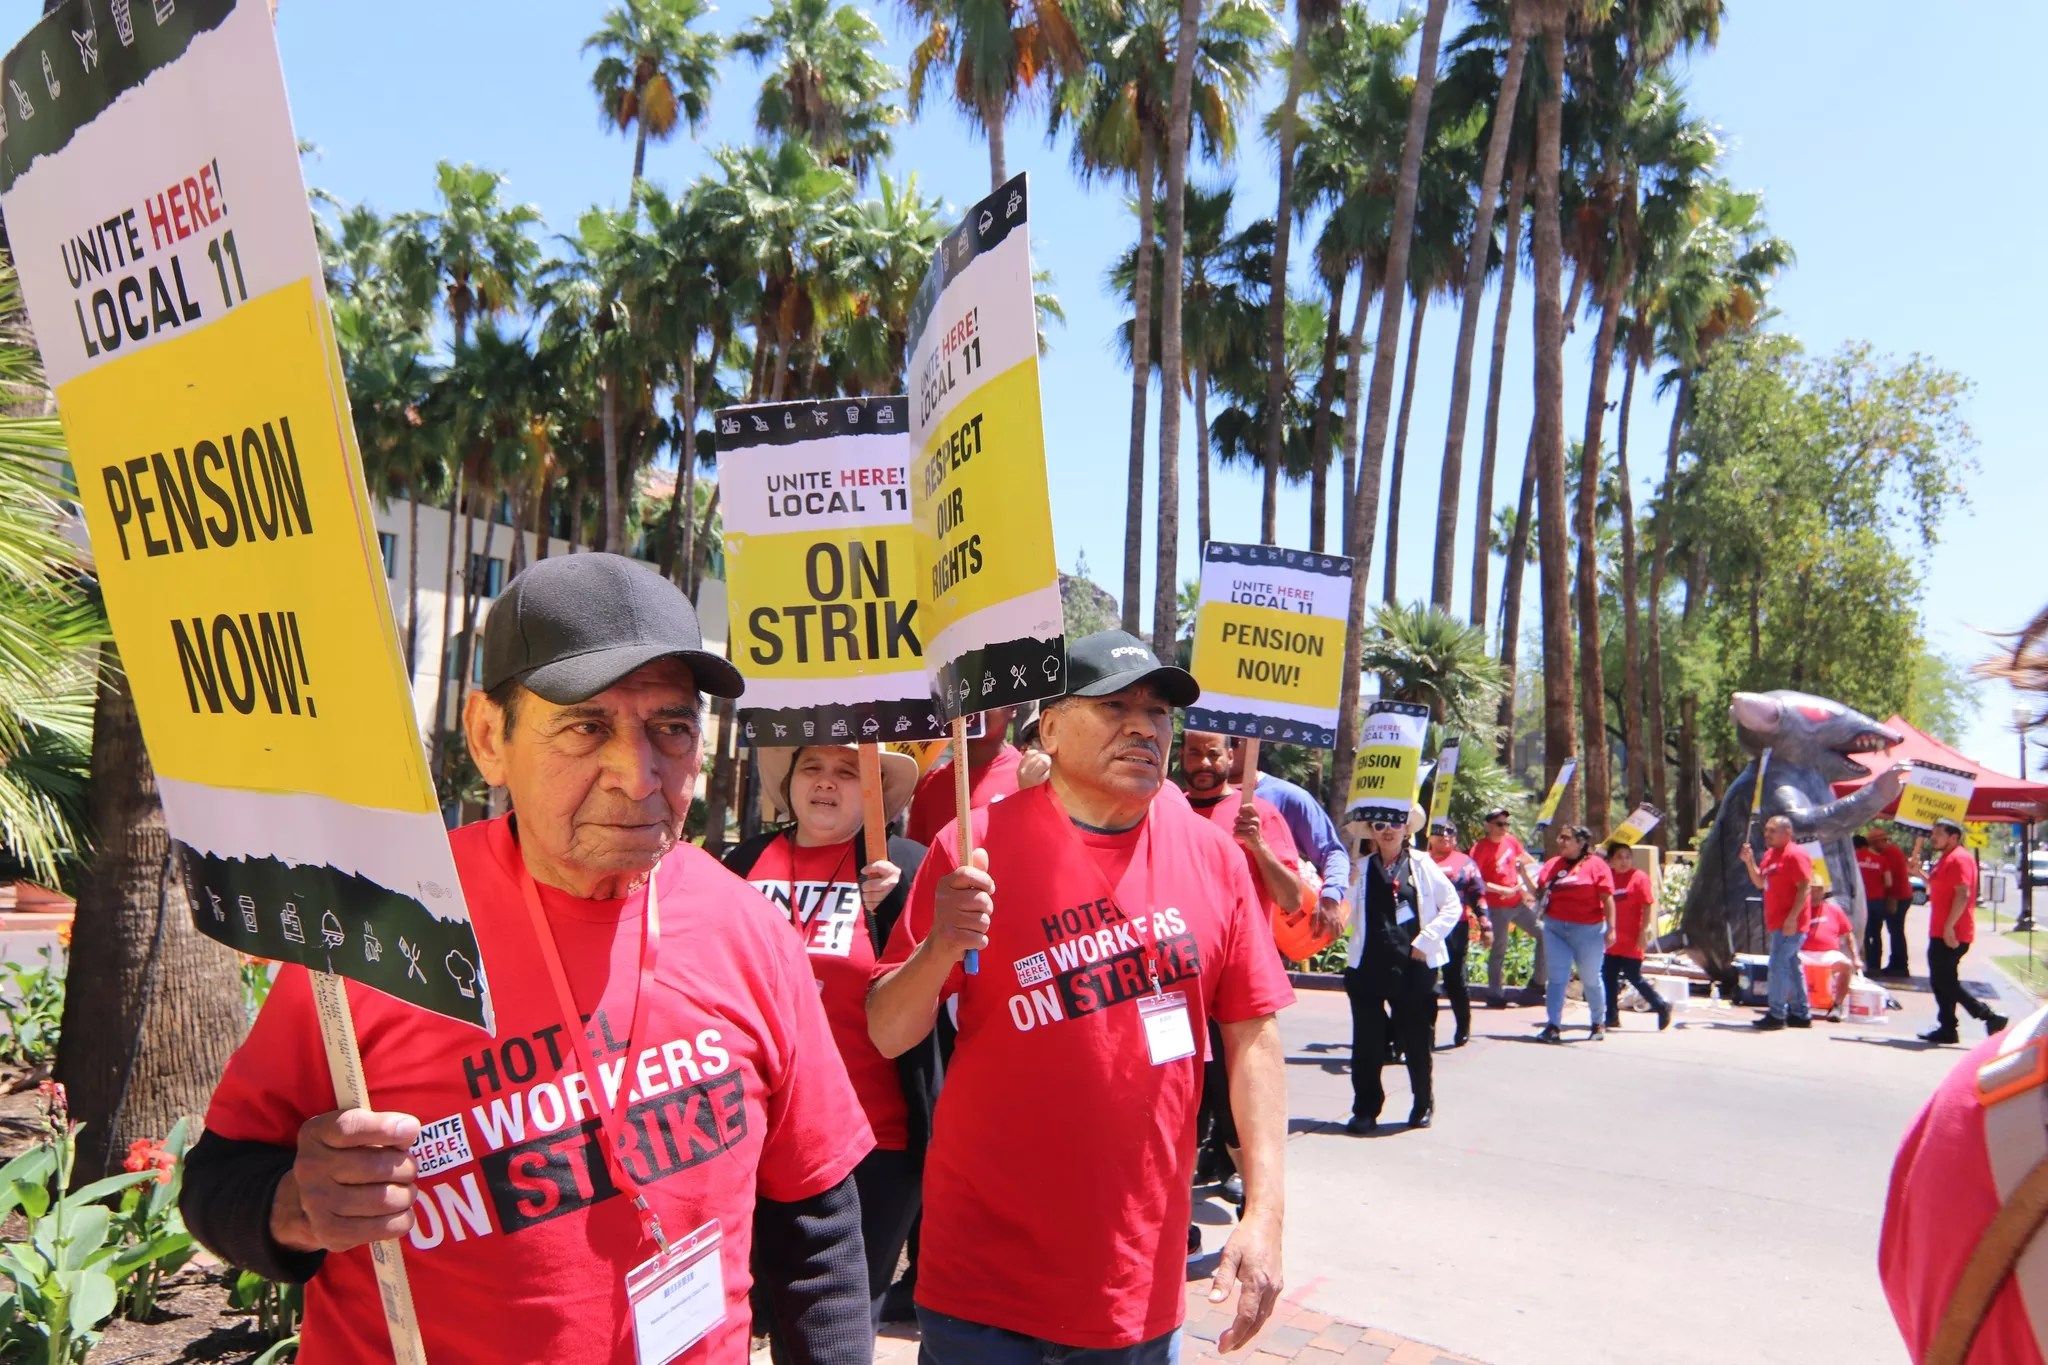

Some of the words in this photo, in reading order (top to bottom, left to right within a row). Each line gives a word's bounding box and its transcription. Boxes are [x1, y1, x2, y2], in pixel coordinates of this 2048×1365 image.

[61, 207, 145, 289] UNITE
[145, 156, 228, 251] HERE!
[74, 254, 202, 358] LOCAL
[207, 229, 248, 309] 11
[920, 345, 940, 396] UNITE
[942, 306, 979, 361] HERE!
[920, 360, 956, 429] LOCAL
[962, 336, 981, 376] 11
[767, 471, 832, 493] UNITE
[840, 467, 906, 488] HERE!
[924, 413, 984, 501] RESPECT
[102, 416, 314, 562] PENSION
[768, 489, 866, 518] LOCAL
[880, 488, 908, 512] 11
[937, 486, 965, 541] OUR
[805, 540, 890, 602] ON
[931, 534, 983, 602] RIGHTS
[1232, 579, 1273, 594] UNITE
[1277, 586, 1315, 601] HERE!
[1231, 591, 1288, 610] LOCAL
[1297, 601, 1313, 615] 11
[748, 599, 923, 666] STRIK
[1221, 622, 1324, 657] PENSION
[170, 611, 318, 719] NOW!
[1237, 658, 1301, 687] NOW!
[1357, 754, 1402, 770] ENSION
[1389, 732, 1400, 741] 11
[1911, 793, 1957, 813] PENSION
[1015, 953, 1045, 971] UNITE
[1050, 907, 1187, 972] WORKERS
[1008, 984, 1064, 1032] ON
[1070, 938, 1199, 1012] STRIKE
[1018, 962, 1048, 979] HERE!
[1021, 974, 1042, 985] LOCAL
[472, 1028, 730, 1151] WORKERS
[409, 1173, 493, 1250] ON
[508, 1079, 745, 1219] STRIKE
[457, 1148, 469, 1159] 11
